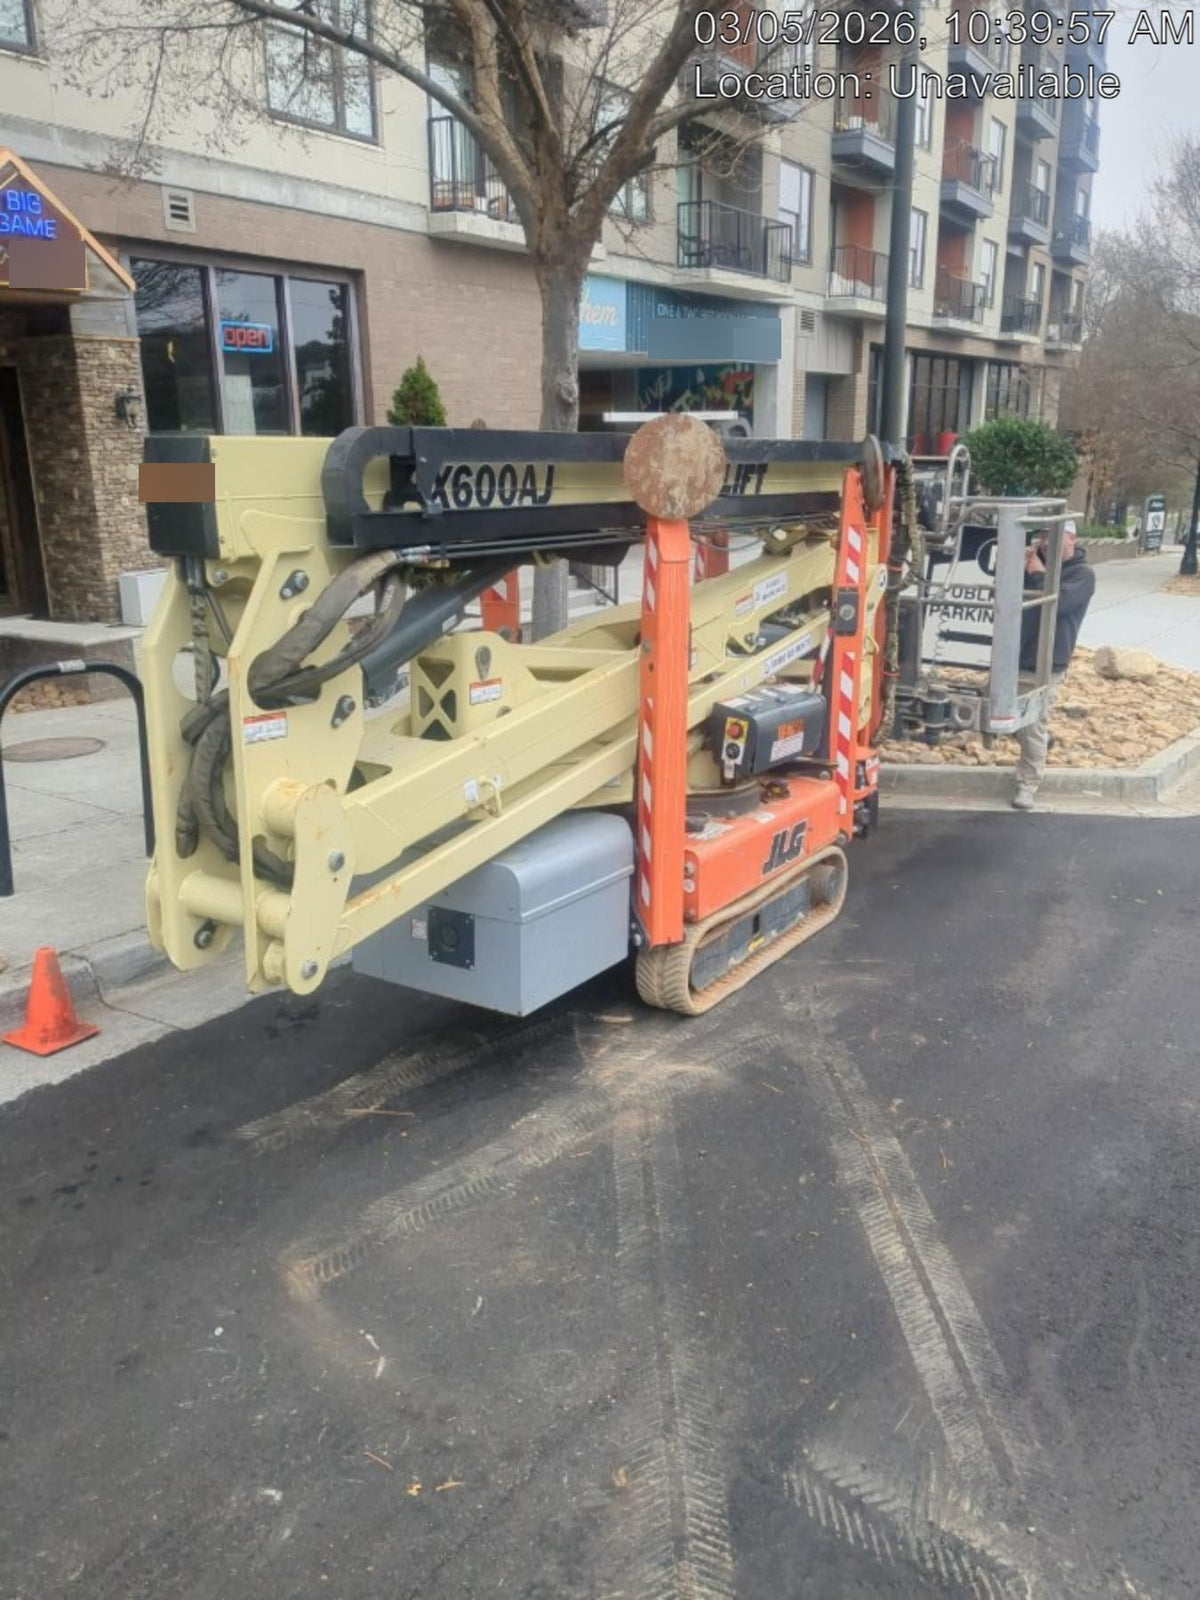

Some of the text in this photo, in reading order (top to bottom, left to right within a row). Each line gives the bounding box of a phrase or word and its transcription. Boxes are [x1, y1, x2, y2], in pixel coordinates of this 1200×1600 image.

[6, 189, 42, 215] BIG
[224, 326, 268, 350] open
[929, 603, 995, 625] PARKIN
[762, 818, 808, 876] JLG
